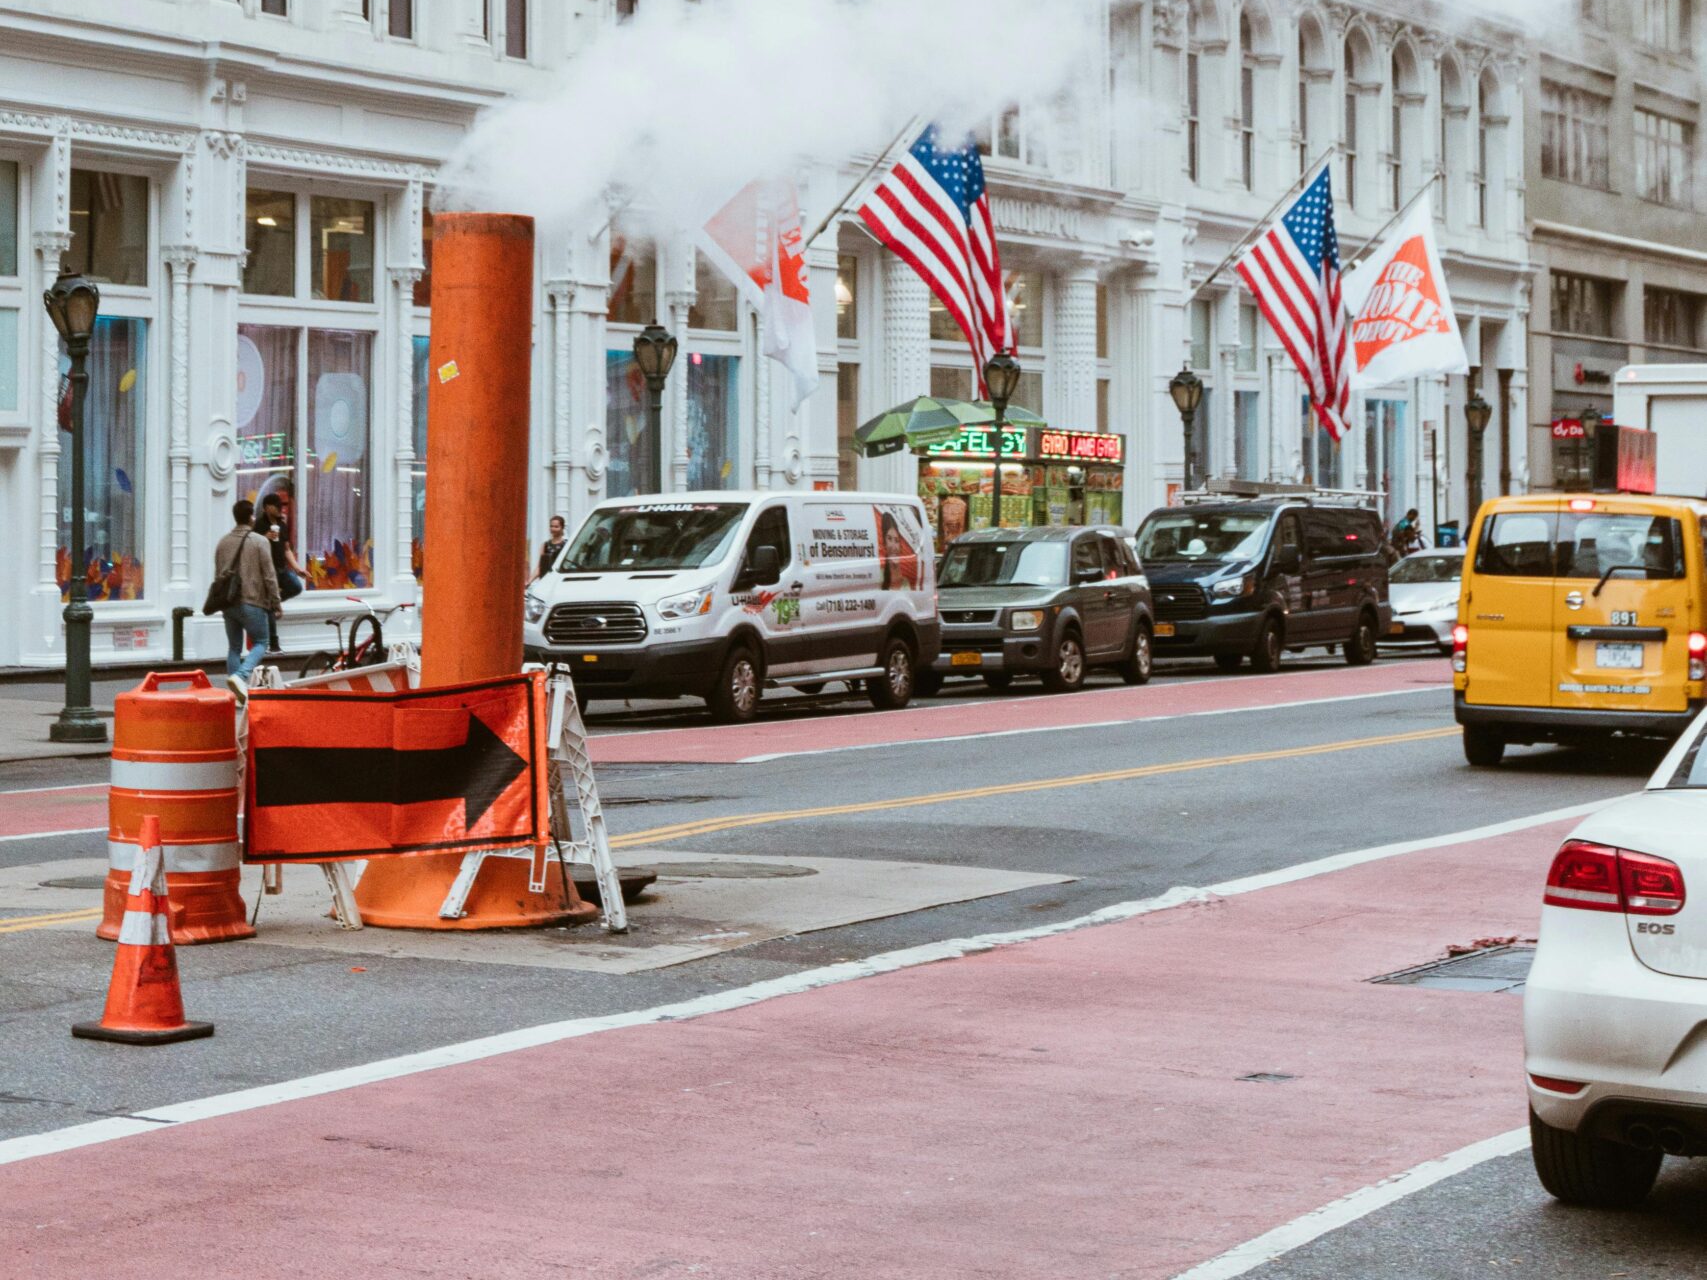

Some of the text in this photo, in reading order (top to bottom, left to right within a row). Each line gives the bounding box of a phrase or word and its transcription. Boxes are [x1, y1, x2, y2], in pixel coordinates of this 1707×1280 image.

[812, 528, 836, 540] MOVING
[843, 528, 869, 540] STORAGE
[809, 542, 875, 557] of Bensonhurst
[1611, 610, 1637, 626] 891
[1637, 922, 1675, 935] EOS
